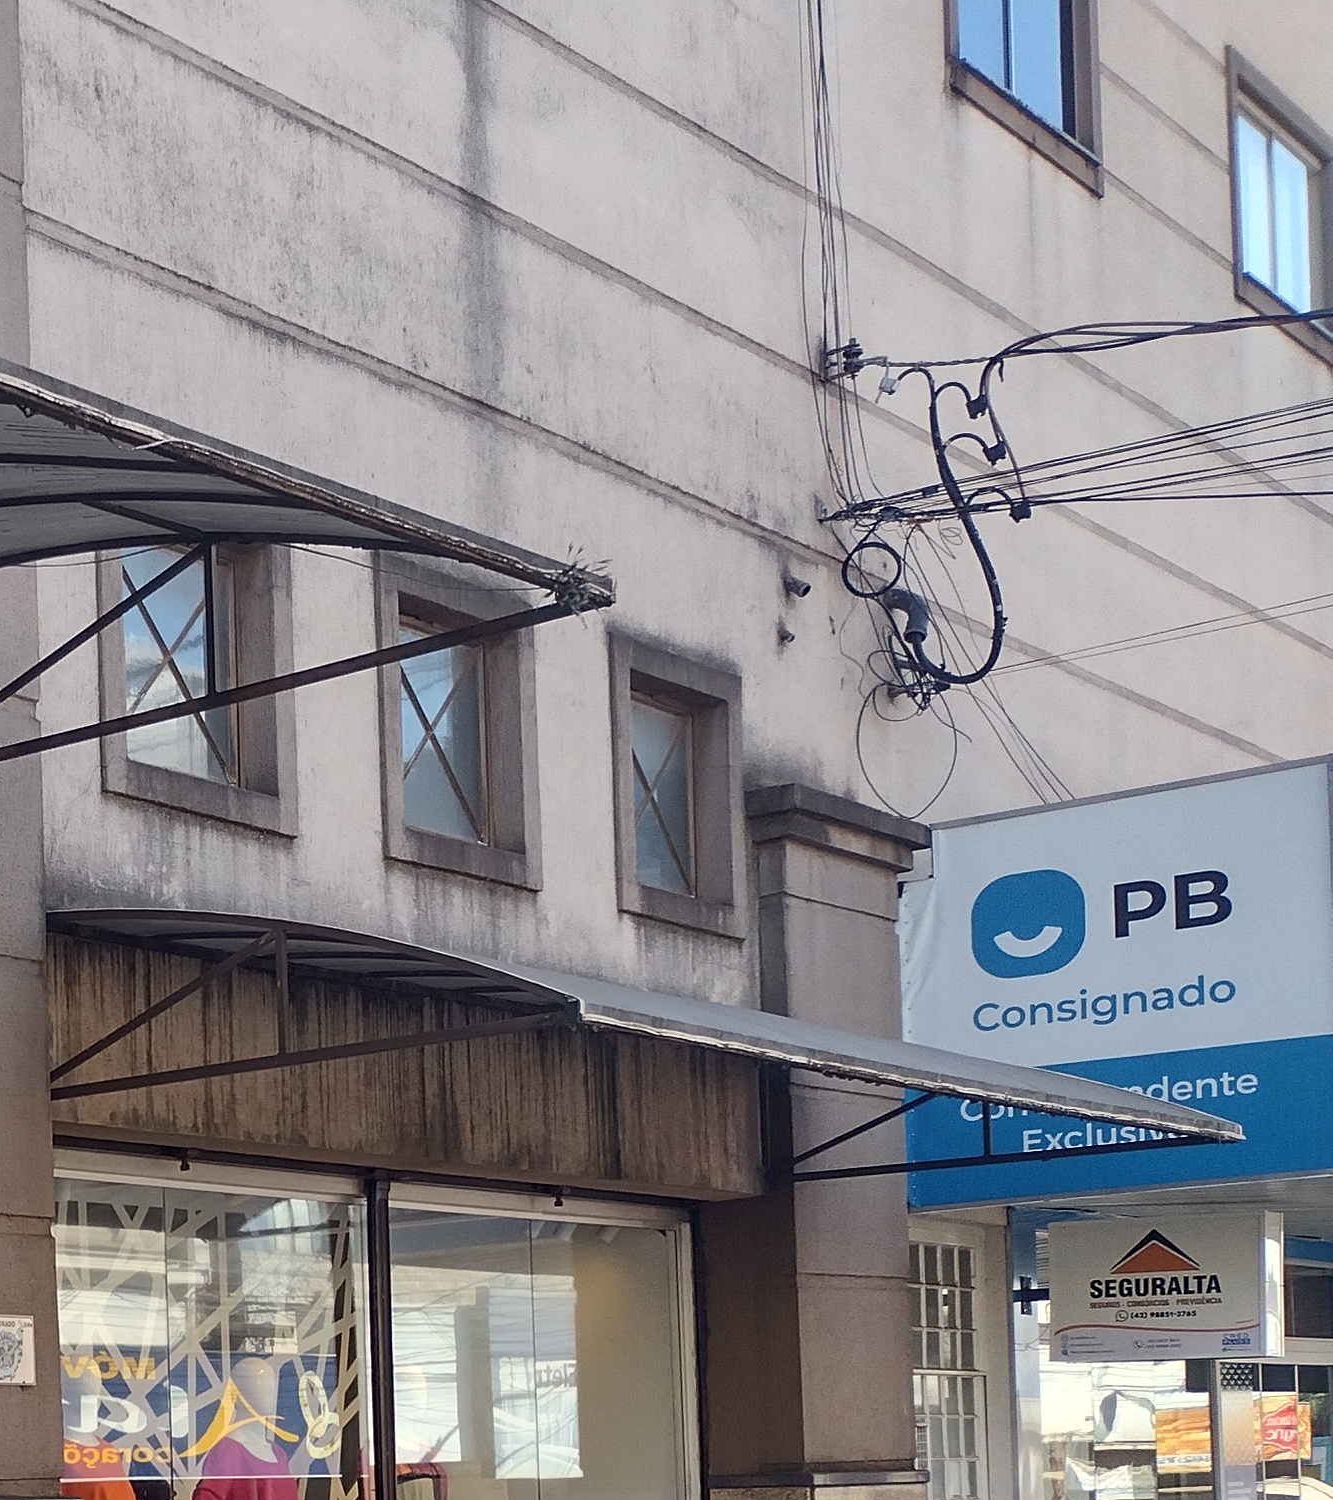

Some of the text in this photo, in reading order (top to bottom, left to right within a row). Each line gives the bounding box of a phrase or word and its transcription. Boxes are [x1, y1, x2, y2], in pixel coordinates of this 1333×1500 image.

[1113, 870, 1233, 939] PB
[972, 974, 1237, 1032] Consignado
[1089, 1274, 1222, 1299] SEGURALTA
